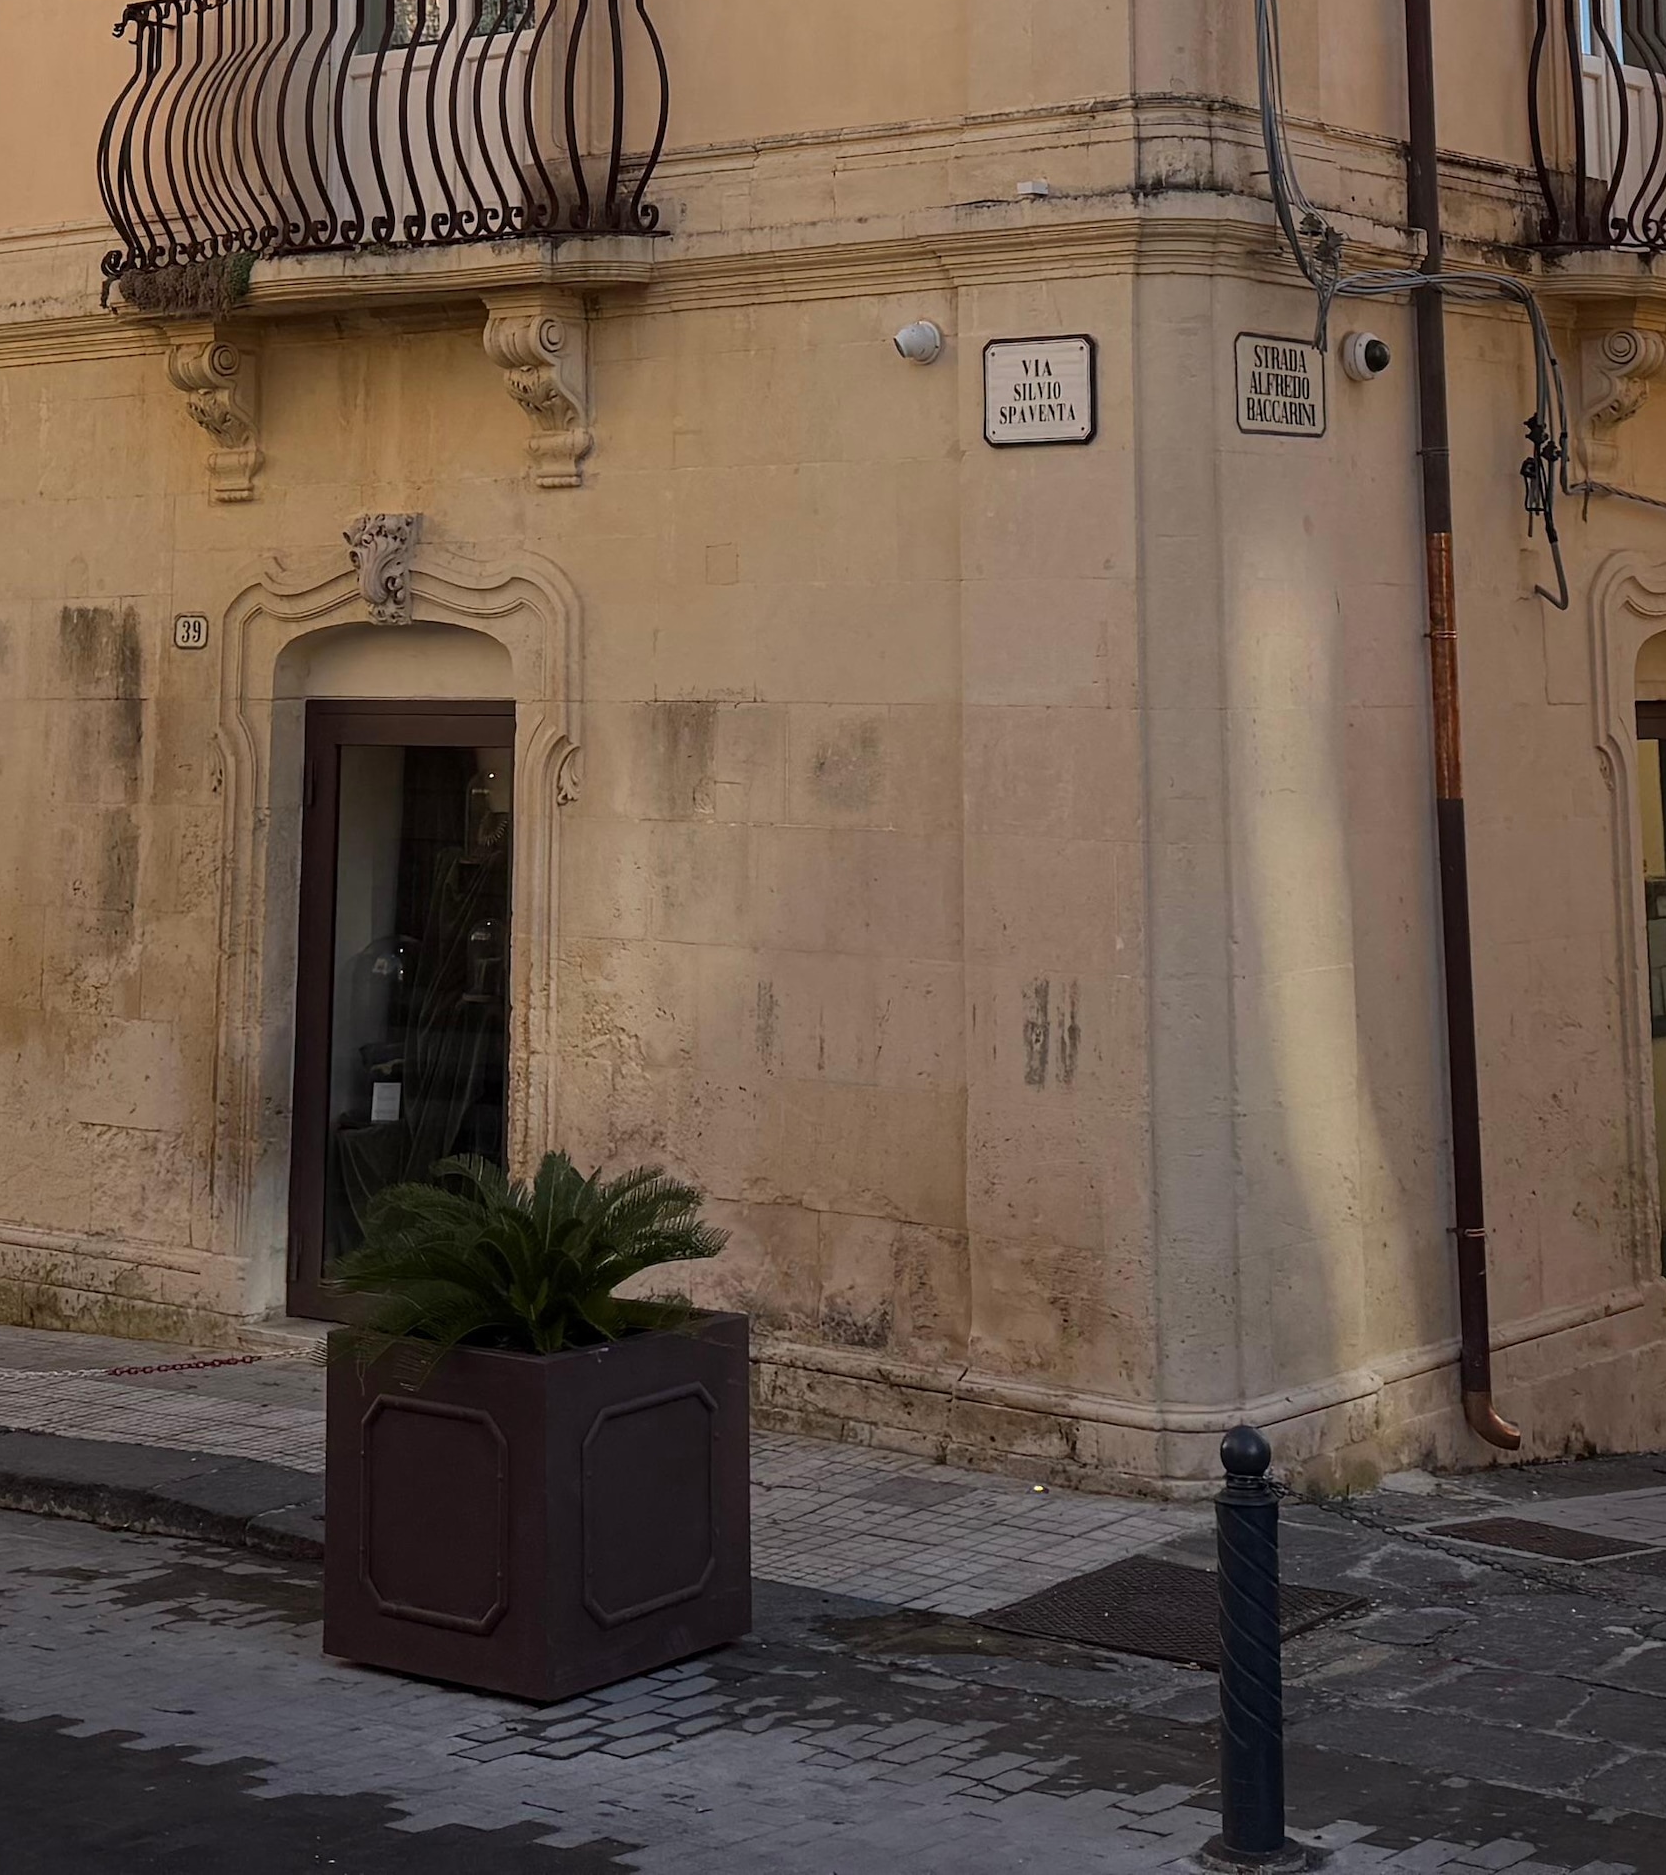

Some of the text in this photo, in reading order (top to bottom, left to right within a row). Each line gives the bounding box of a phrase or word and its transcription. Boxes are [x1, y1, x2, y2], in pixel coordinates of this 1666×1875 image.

[1022, 359, 1053, 378] VIA
[1254, 344, 1308, 373] STRADA
[1013, 381, 1061, 402] SILVIO
[1250, 370, 1310, 400] ALFREDO
[999, 403, 1076, 425] SPAVENTA
[1246, 397, 1316, 427] BACCARINI
[181, 620, 201, 643] 39
